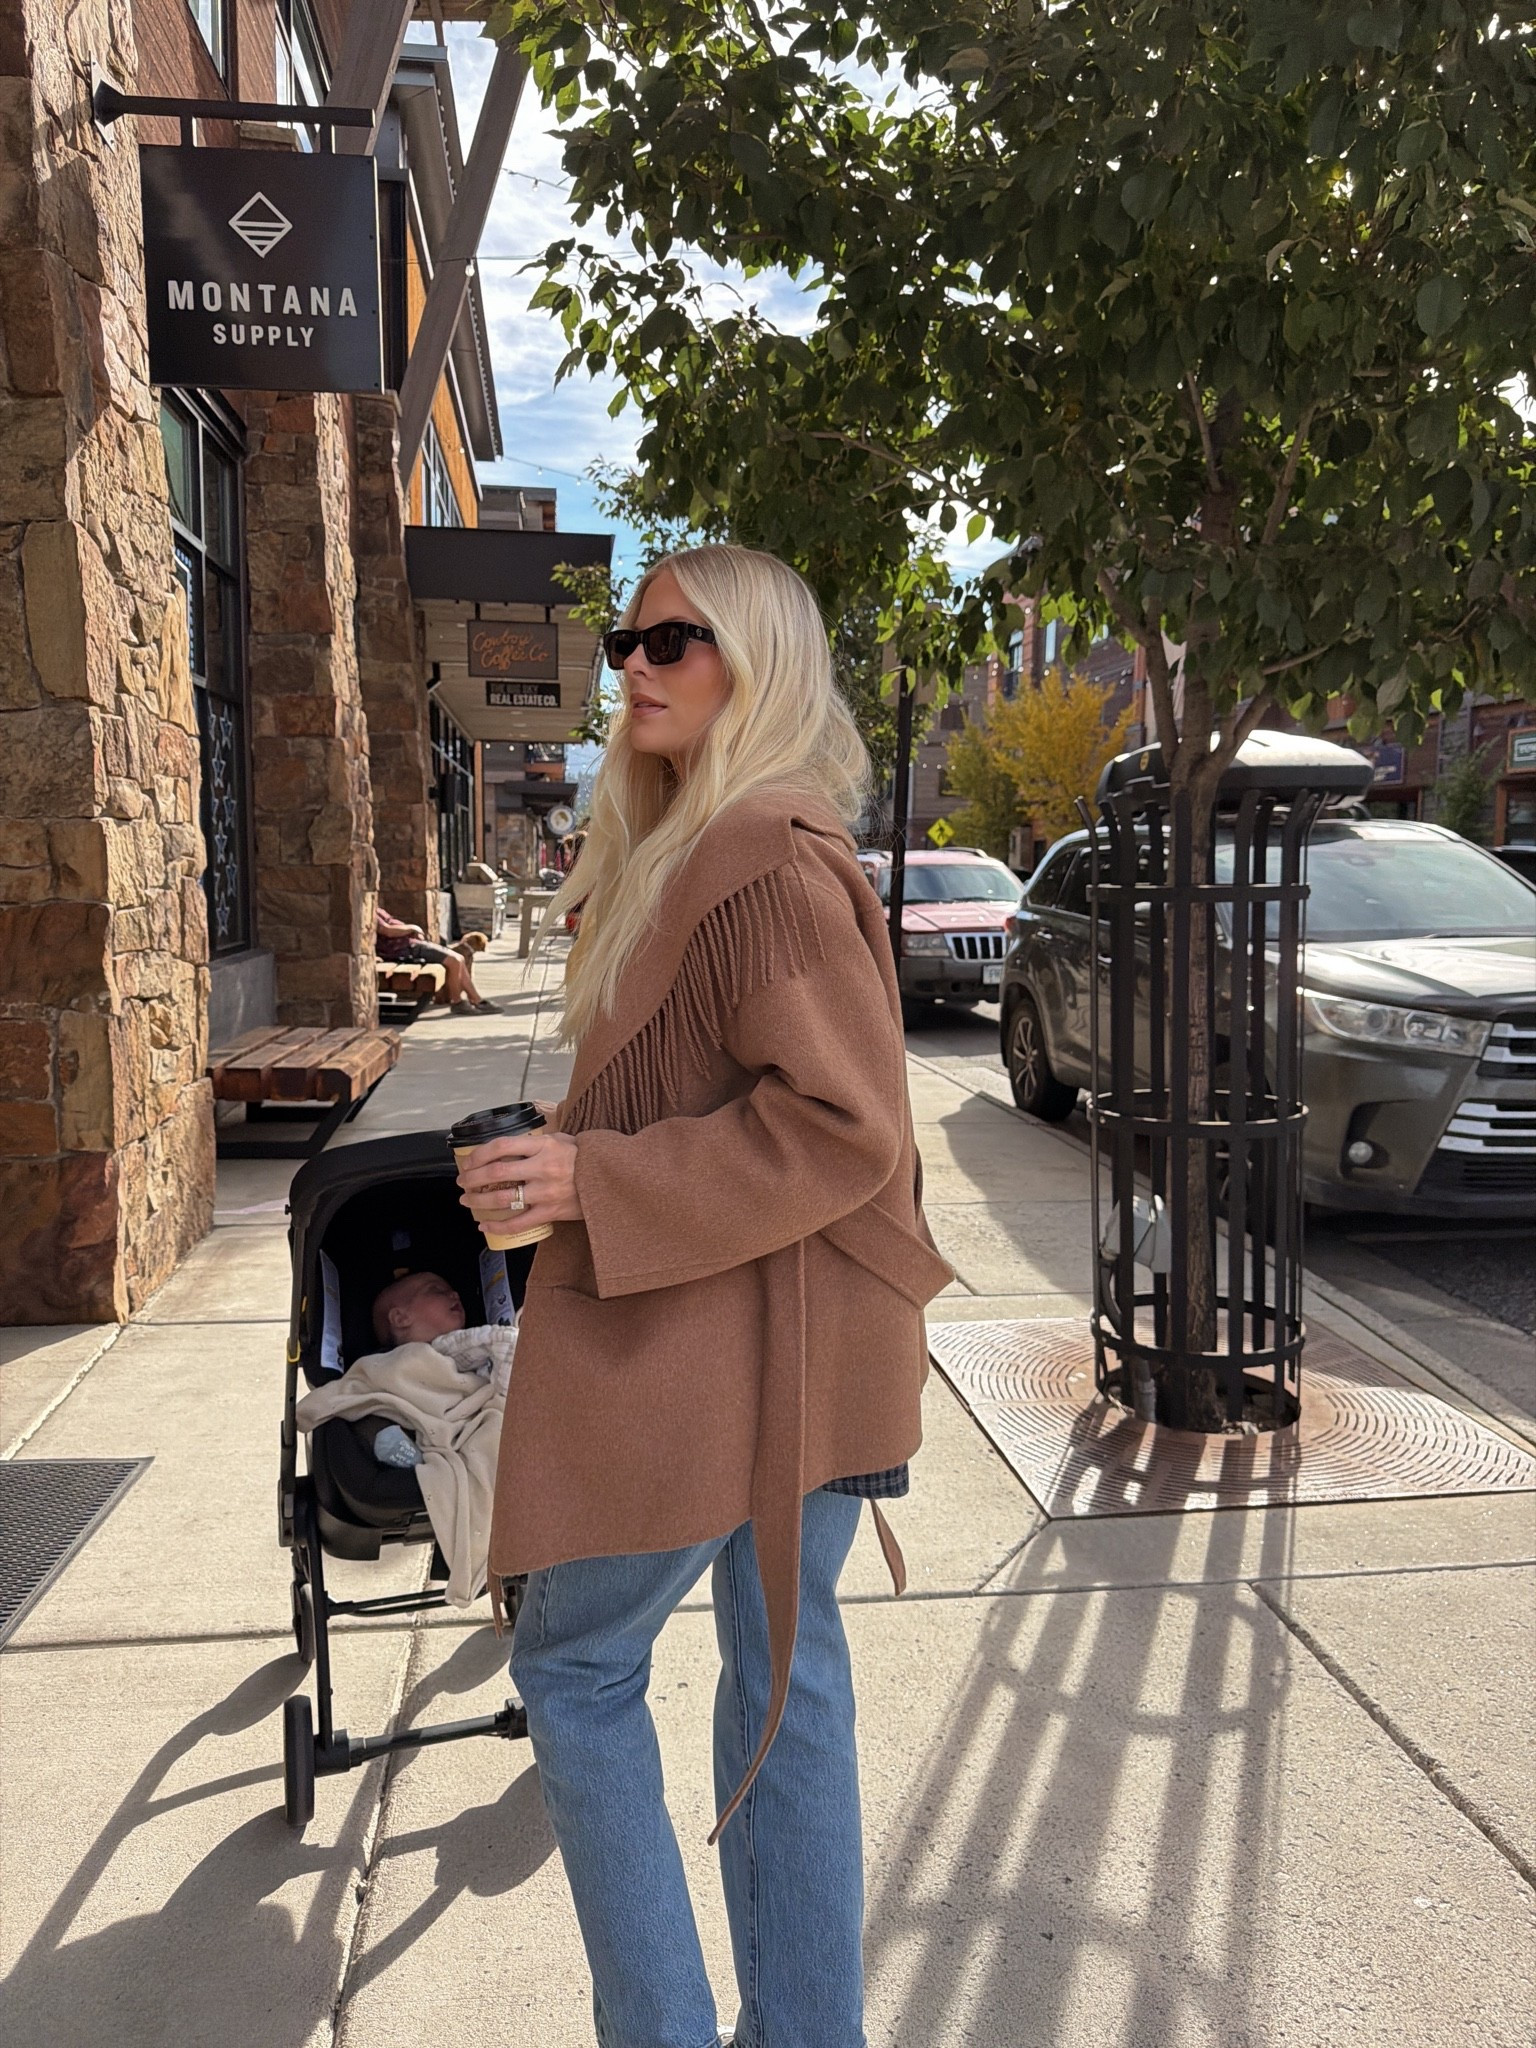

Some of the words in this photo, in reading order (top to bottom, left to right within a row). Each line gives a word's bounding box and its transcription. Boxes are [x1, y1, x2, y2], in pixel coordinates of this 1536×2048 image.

[167, 280, 358, 317] MONTANA
[212, 323, 314, 347] SUPPLY
[480, 645, 527, 670] Coffee
[490, 693, 512, 705] REAL
[513, 694, 542, 706] ESTATE
